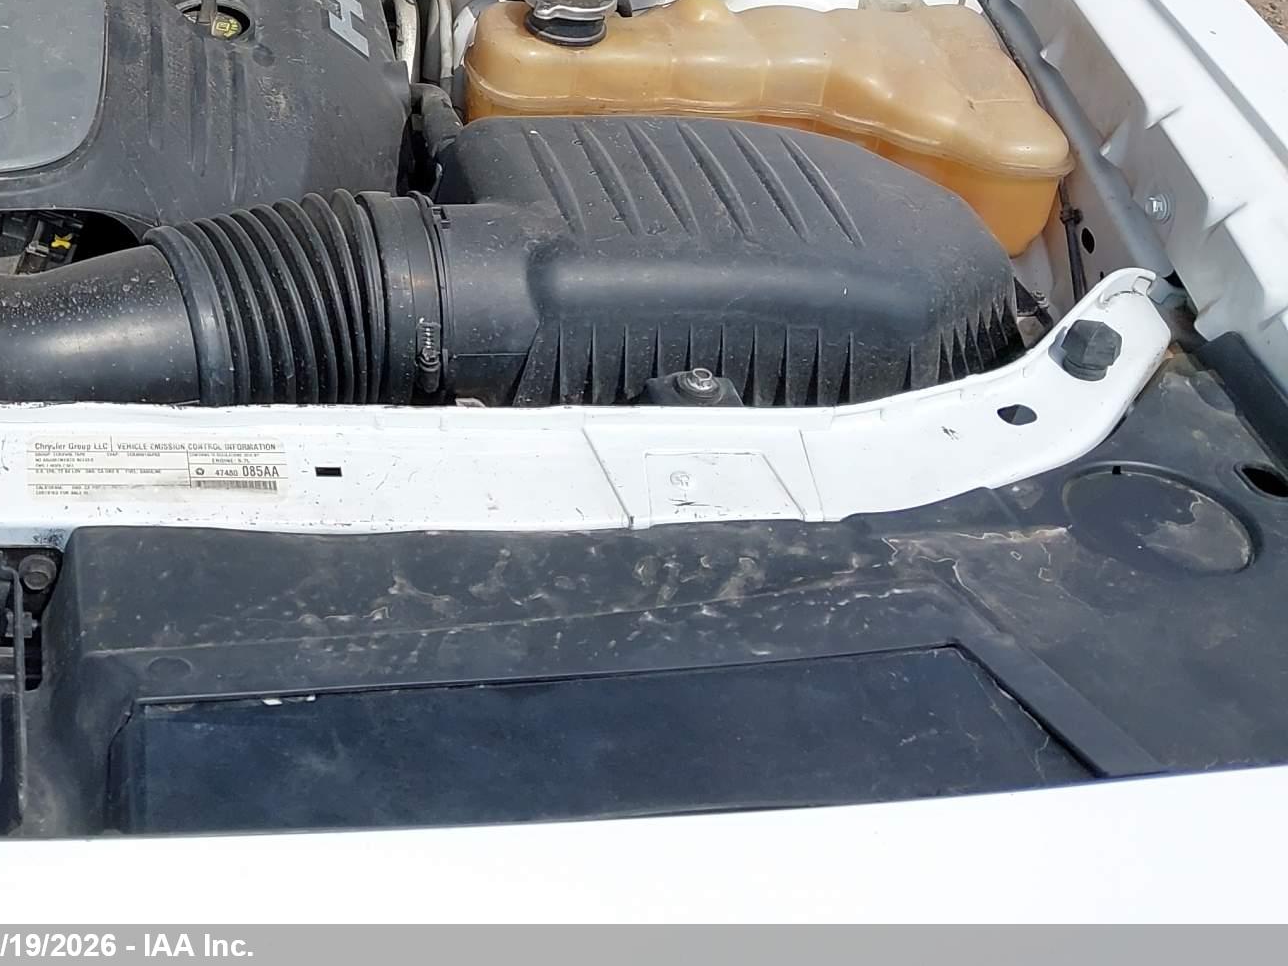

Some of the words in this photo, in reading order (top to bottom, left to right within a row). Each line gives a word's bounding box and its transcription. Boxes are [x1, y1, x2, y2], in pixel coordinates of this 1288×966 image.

[68, 442, 91, 451] Group
[93, 442, 108, 450] LLC
[117, 443, 148, 451] VEHICLE
[187, 443, 222, 451] CONTROL
[224, 443, 276, 451] INFORMATION
[242, 465, 280, 477] 085AA
